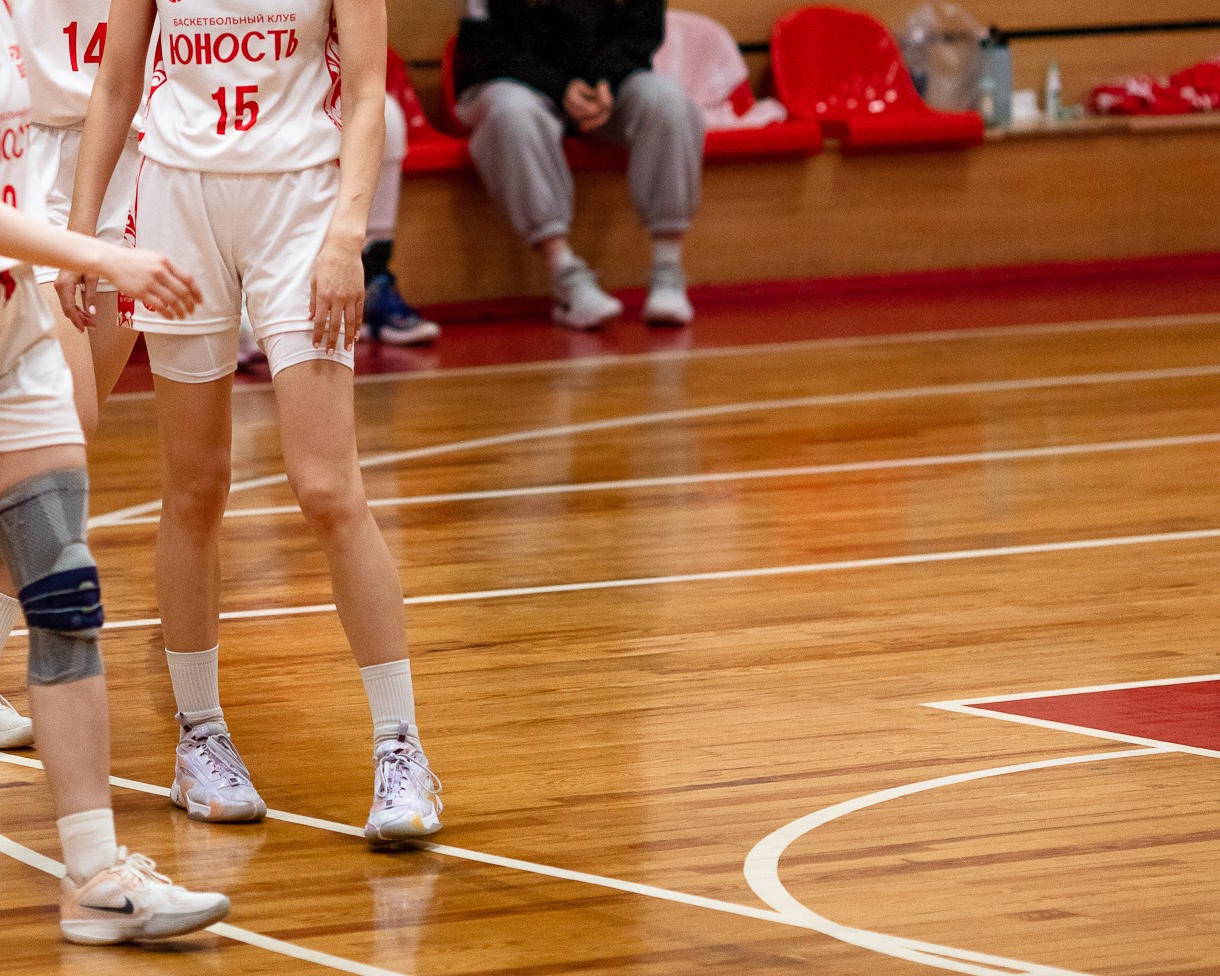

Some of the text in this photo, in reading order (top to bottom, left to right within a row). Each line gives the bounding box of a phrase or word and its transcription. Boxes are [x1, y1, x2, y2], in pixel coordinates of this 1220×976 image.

[173, 13, 296, 27] БАСКЕТБОЛЬНЫЙ КЛУБ
[62, 21, 108, 72] 14
[169, 29, 299, 65] ЮНОСТЬ
[211, 85, 260, 135] 15
